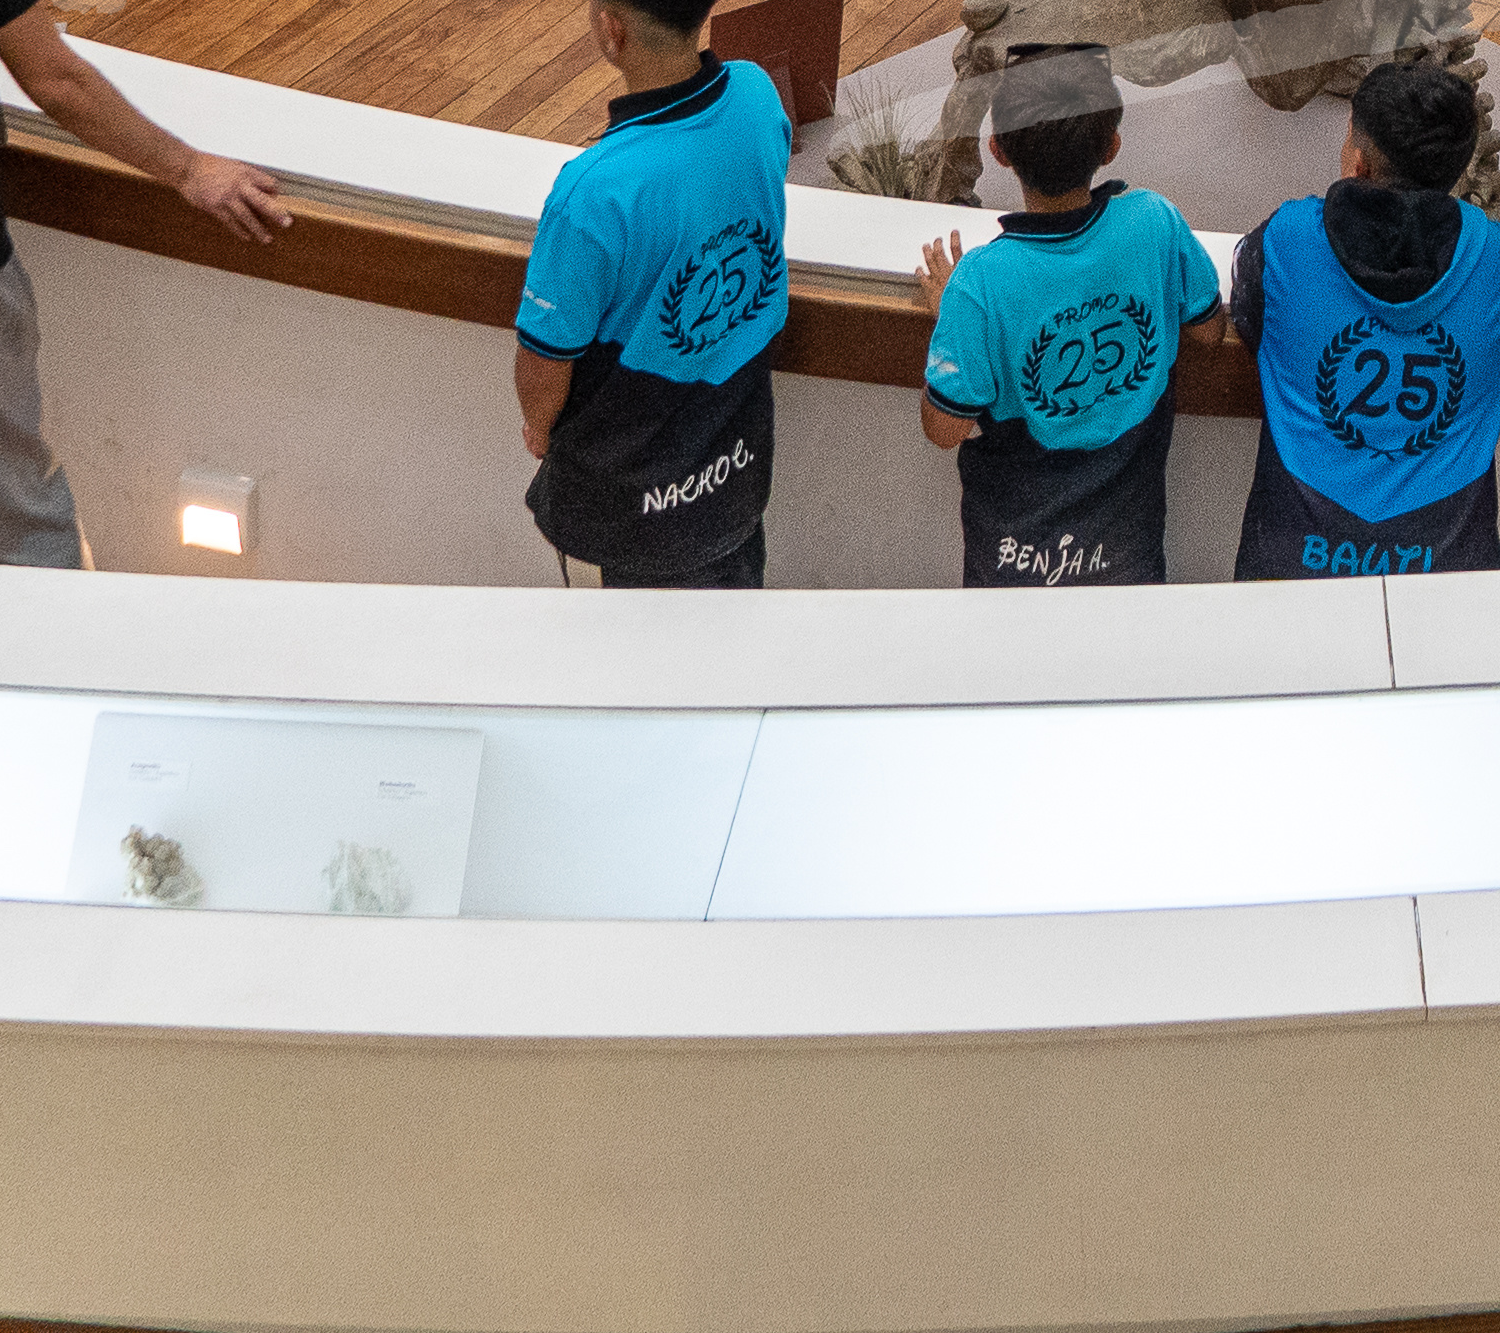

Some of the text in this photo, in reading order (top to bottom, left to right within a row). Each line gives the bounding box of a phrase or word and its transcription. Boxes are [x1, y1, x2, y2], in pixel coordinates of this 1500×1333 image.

[700, 216, 750, 258] PROMO
[696, 245, 750, 314] 25
[1053, 293, 1120, 330] PROMO
[1055, 323, 1126, 395] 25
[1346, 348, 1441, 421] 25
[1302, 533, 1434, 577] BAUTI
